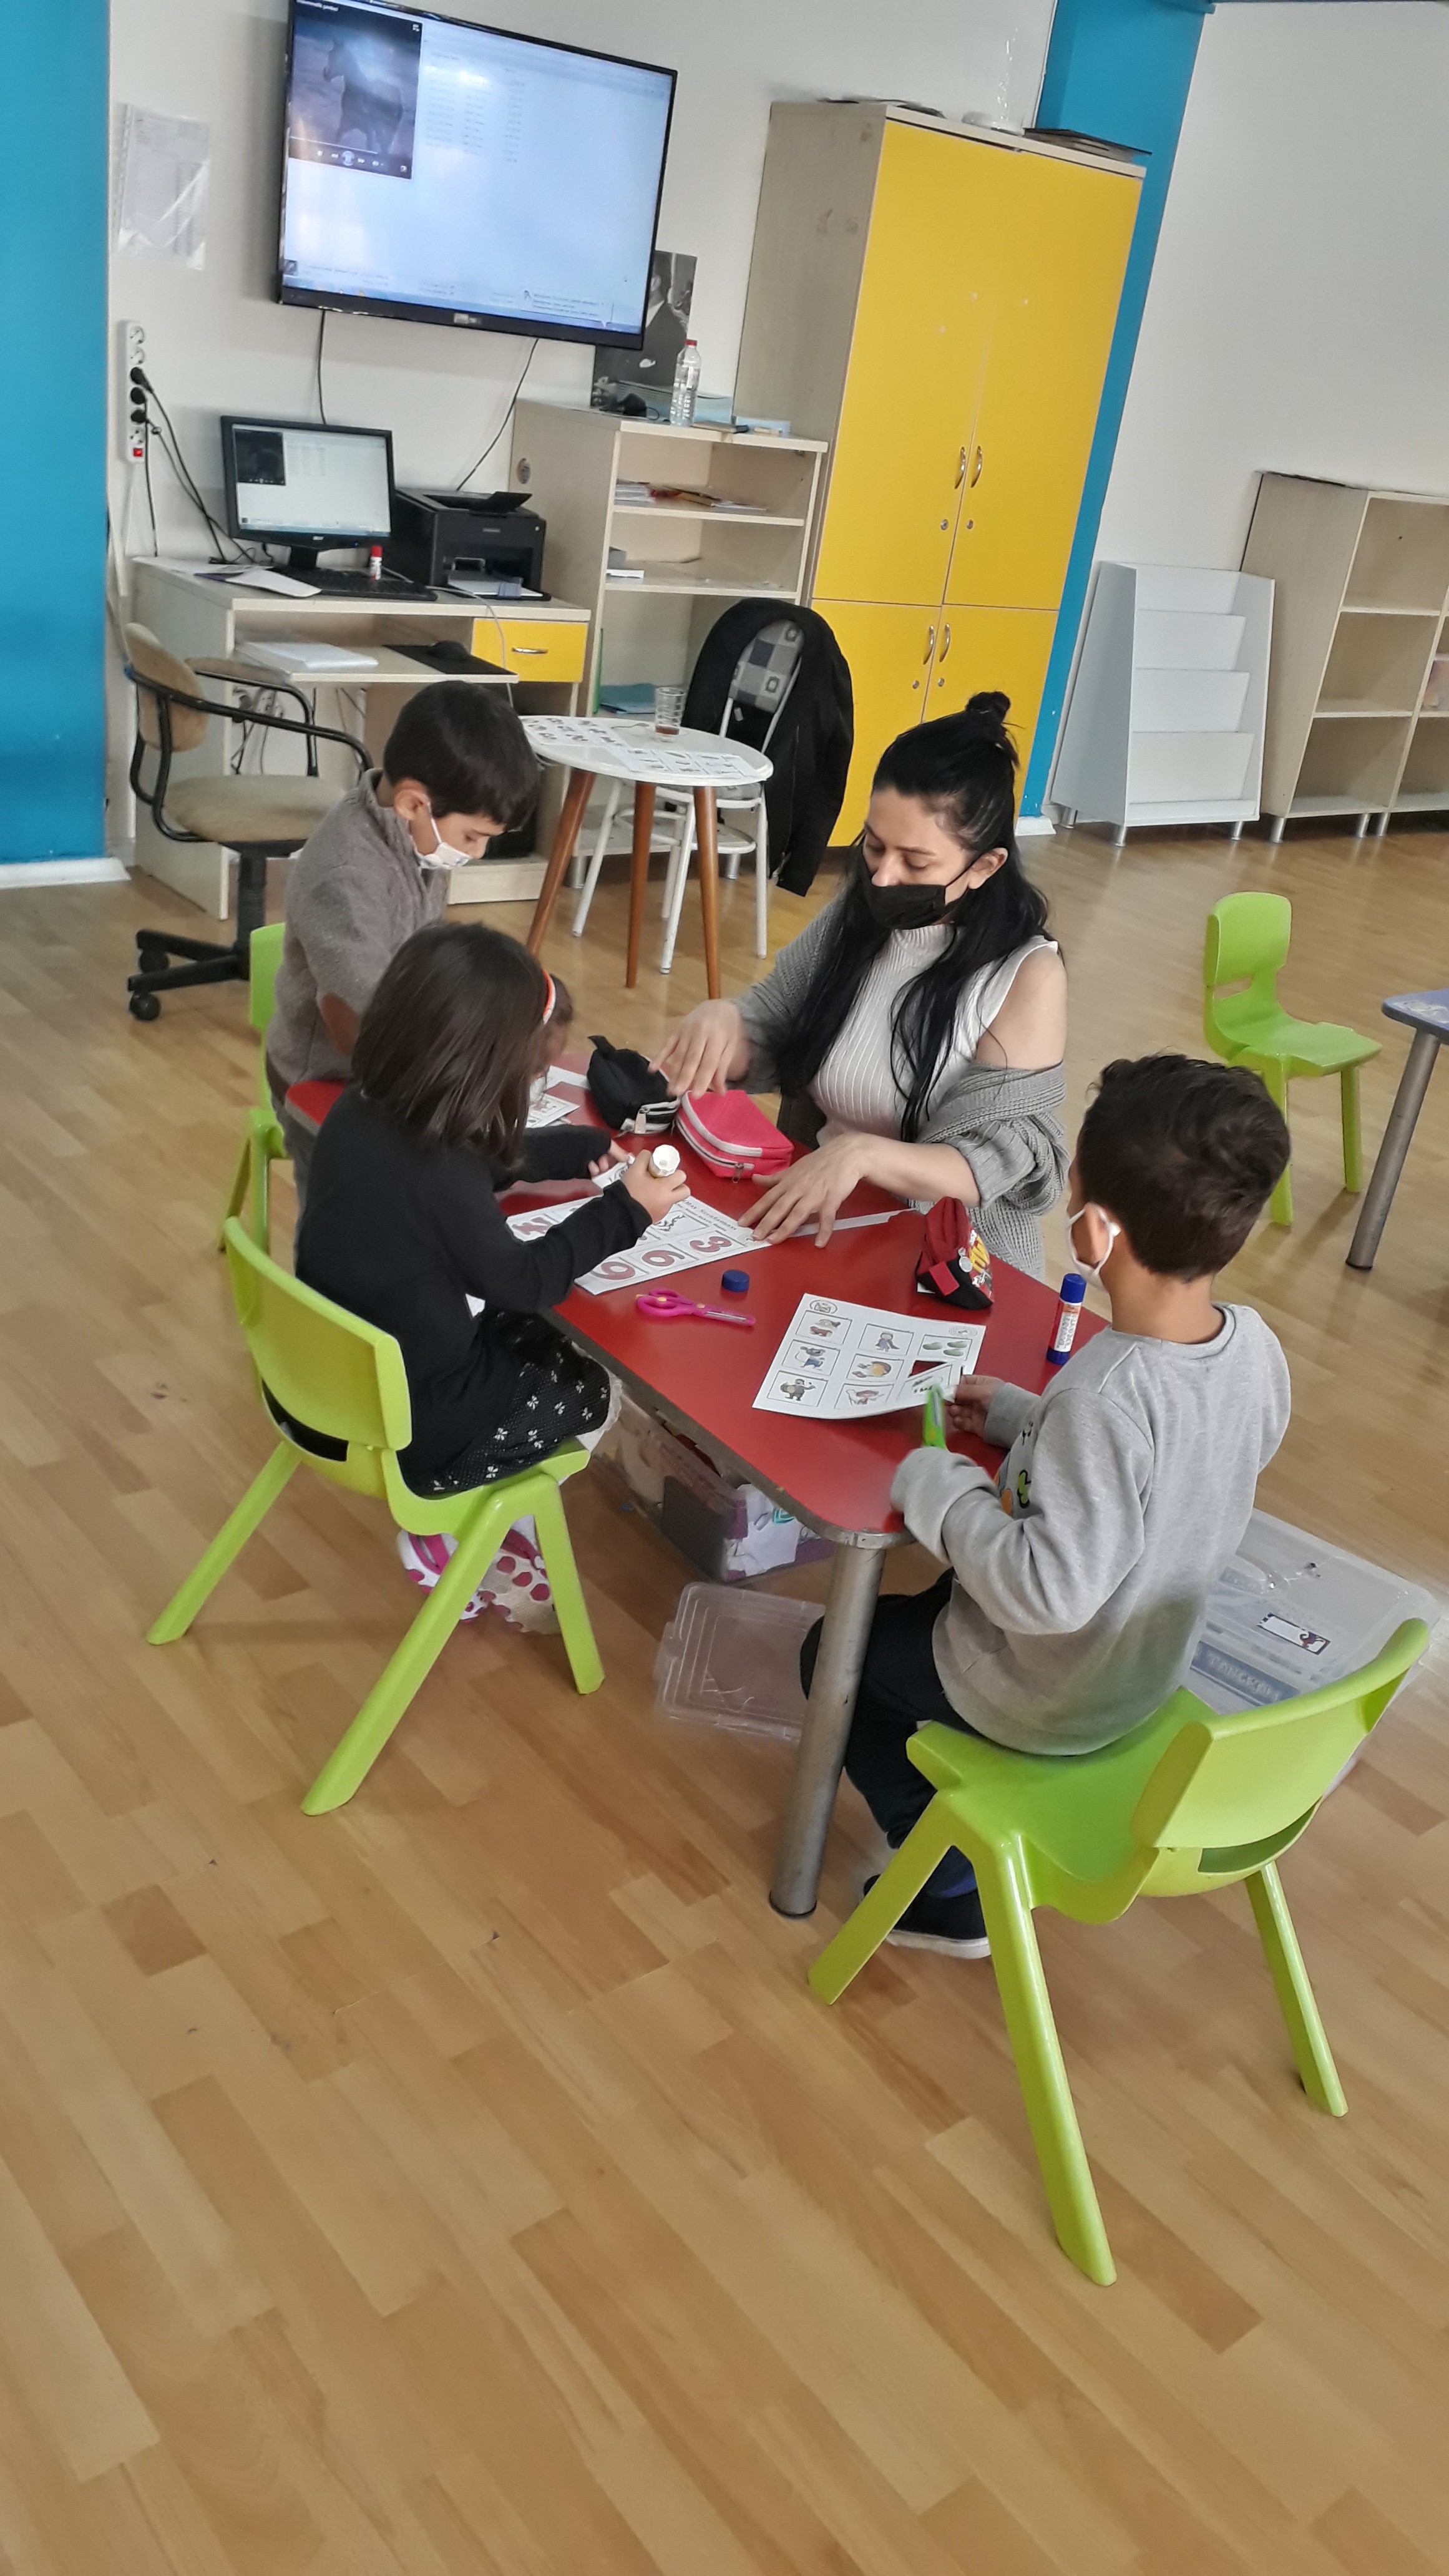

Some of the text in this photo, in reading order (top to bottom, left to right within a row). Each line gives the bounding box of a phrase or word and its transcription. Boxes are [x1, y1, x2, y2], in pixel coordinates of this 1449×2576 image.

[690, 1236, 733, 1252] 3
[642, 1250, 685, 1267] 6
[590, 1261, 635, 1281] 9
